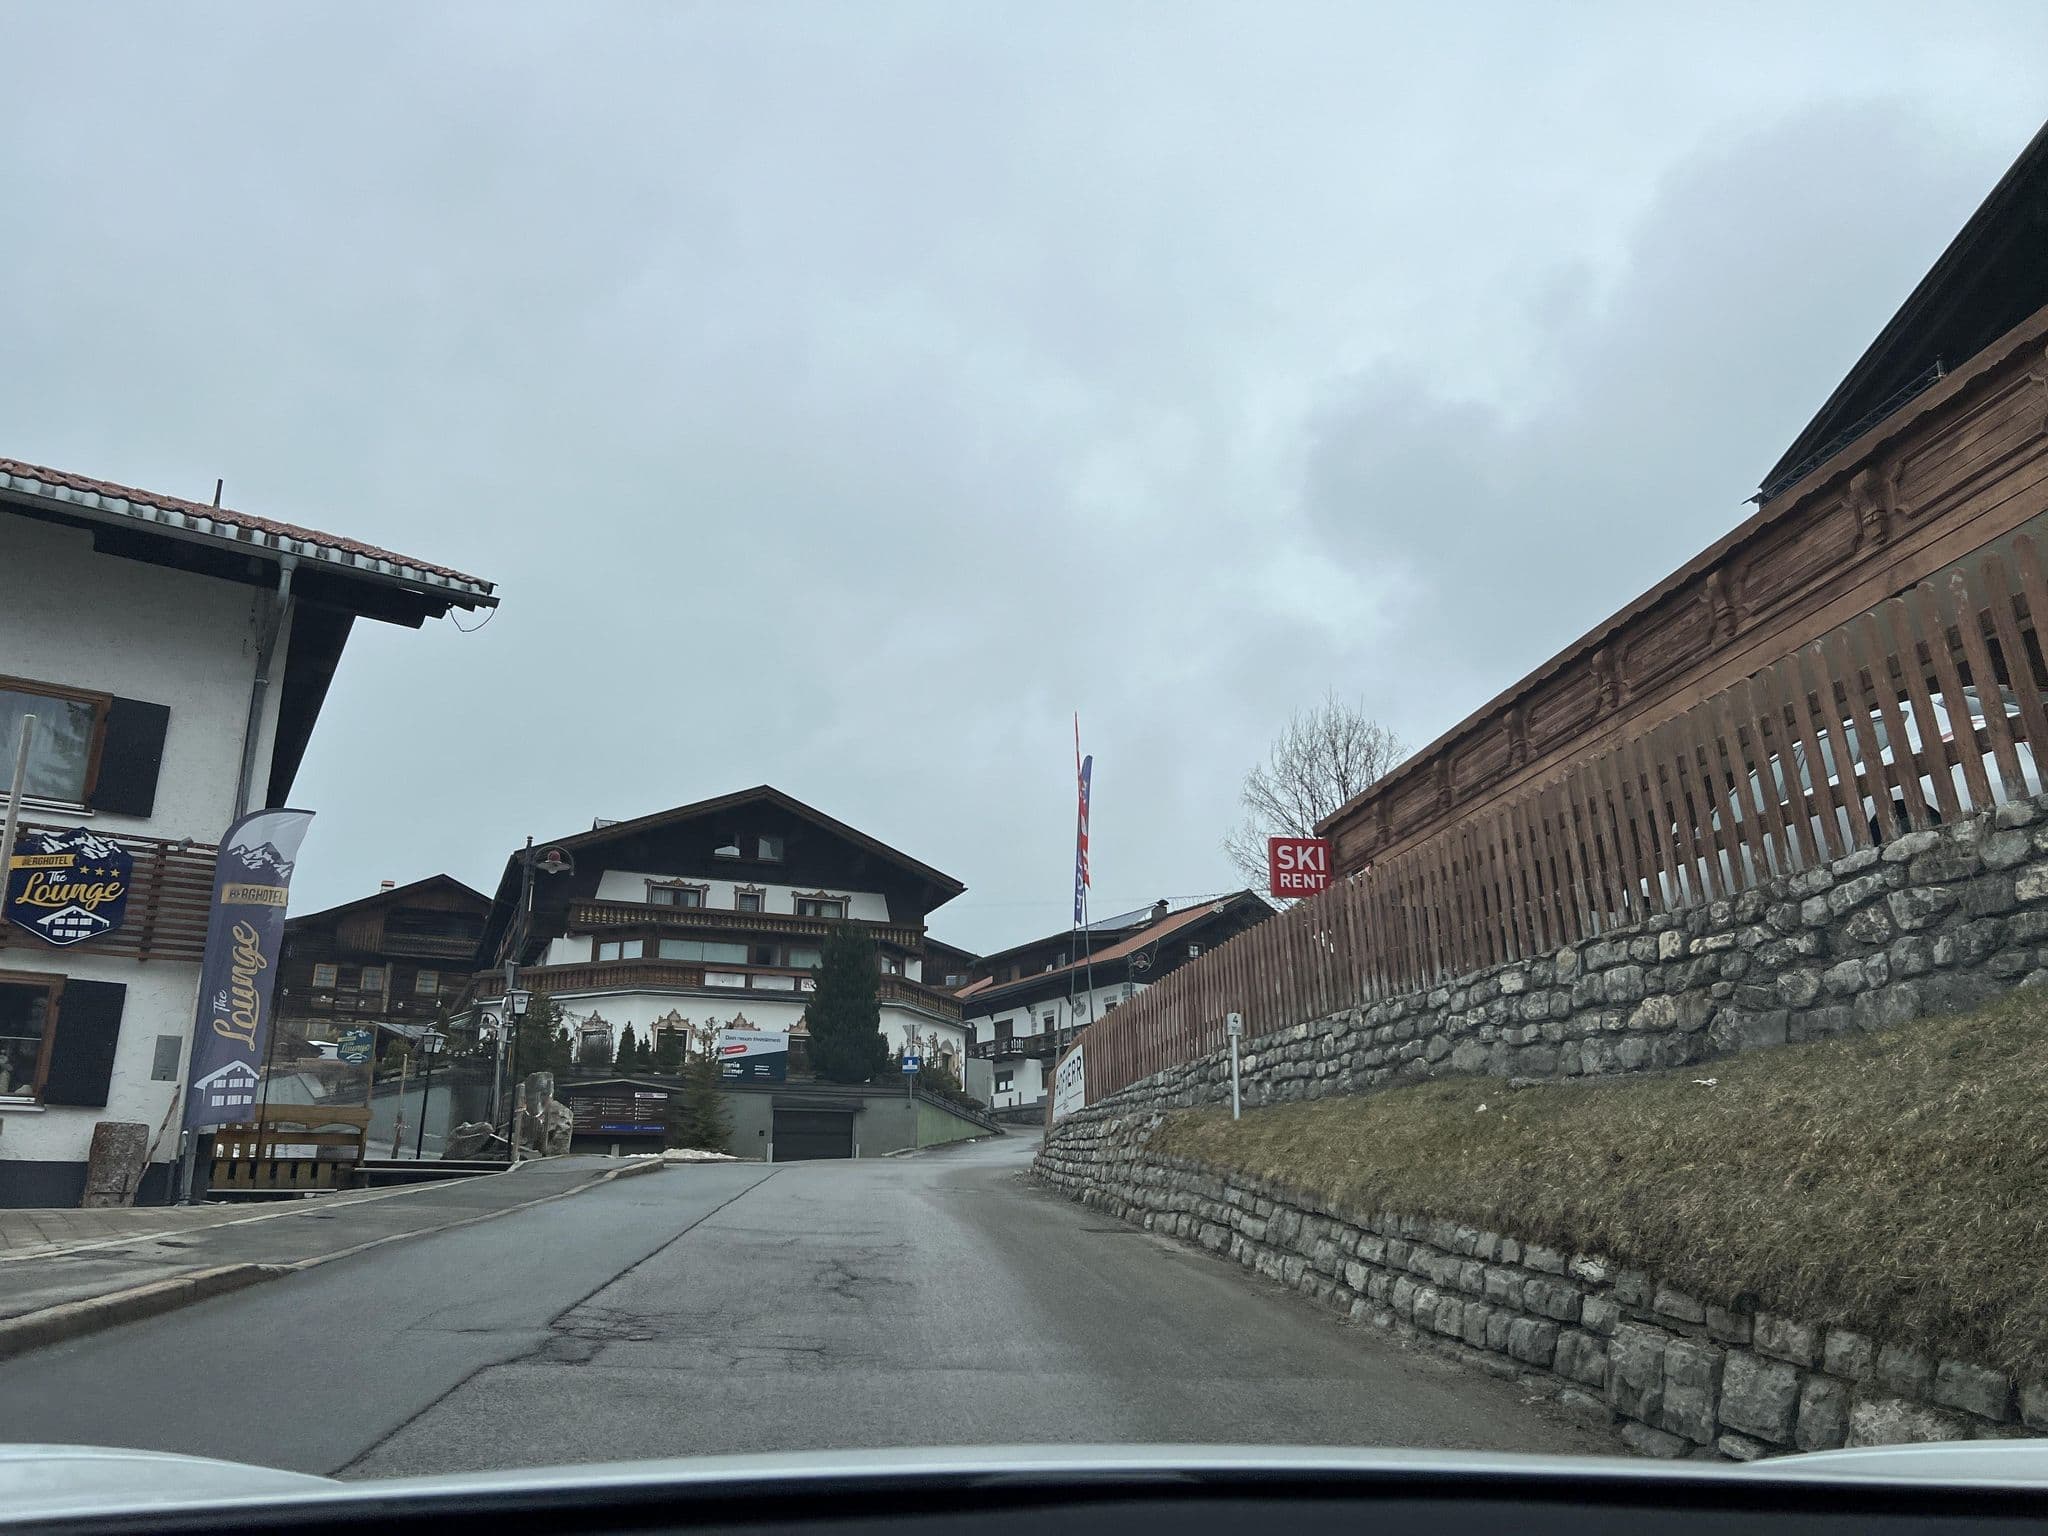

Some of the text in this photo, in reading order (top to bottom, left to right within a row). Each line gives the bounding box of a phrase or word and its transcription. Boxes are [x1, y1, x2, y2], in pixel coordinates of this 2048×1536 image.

[1277, 845, 1325, 871] SKI
[46, 870, 68, 885] The
[1280, 873, 1327, 889] RENT
[15, 871, 125, 911] Lounge
[213, 920, 268, 1052] Lounge
[213, 989, 231, 1015] The
